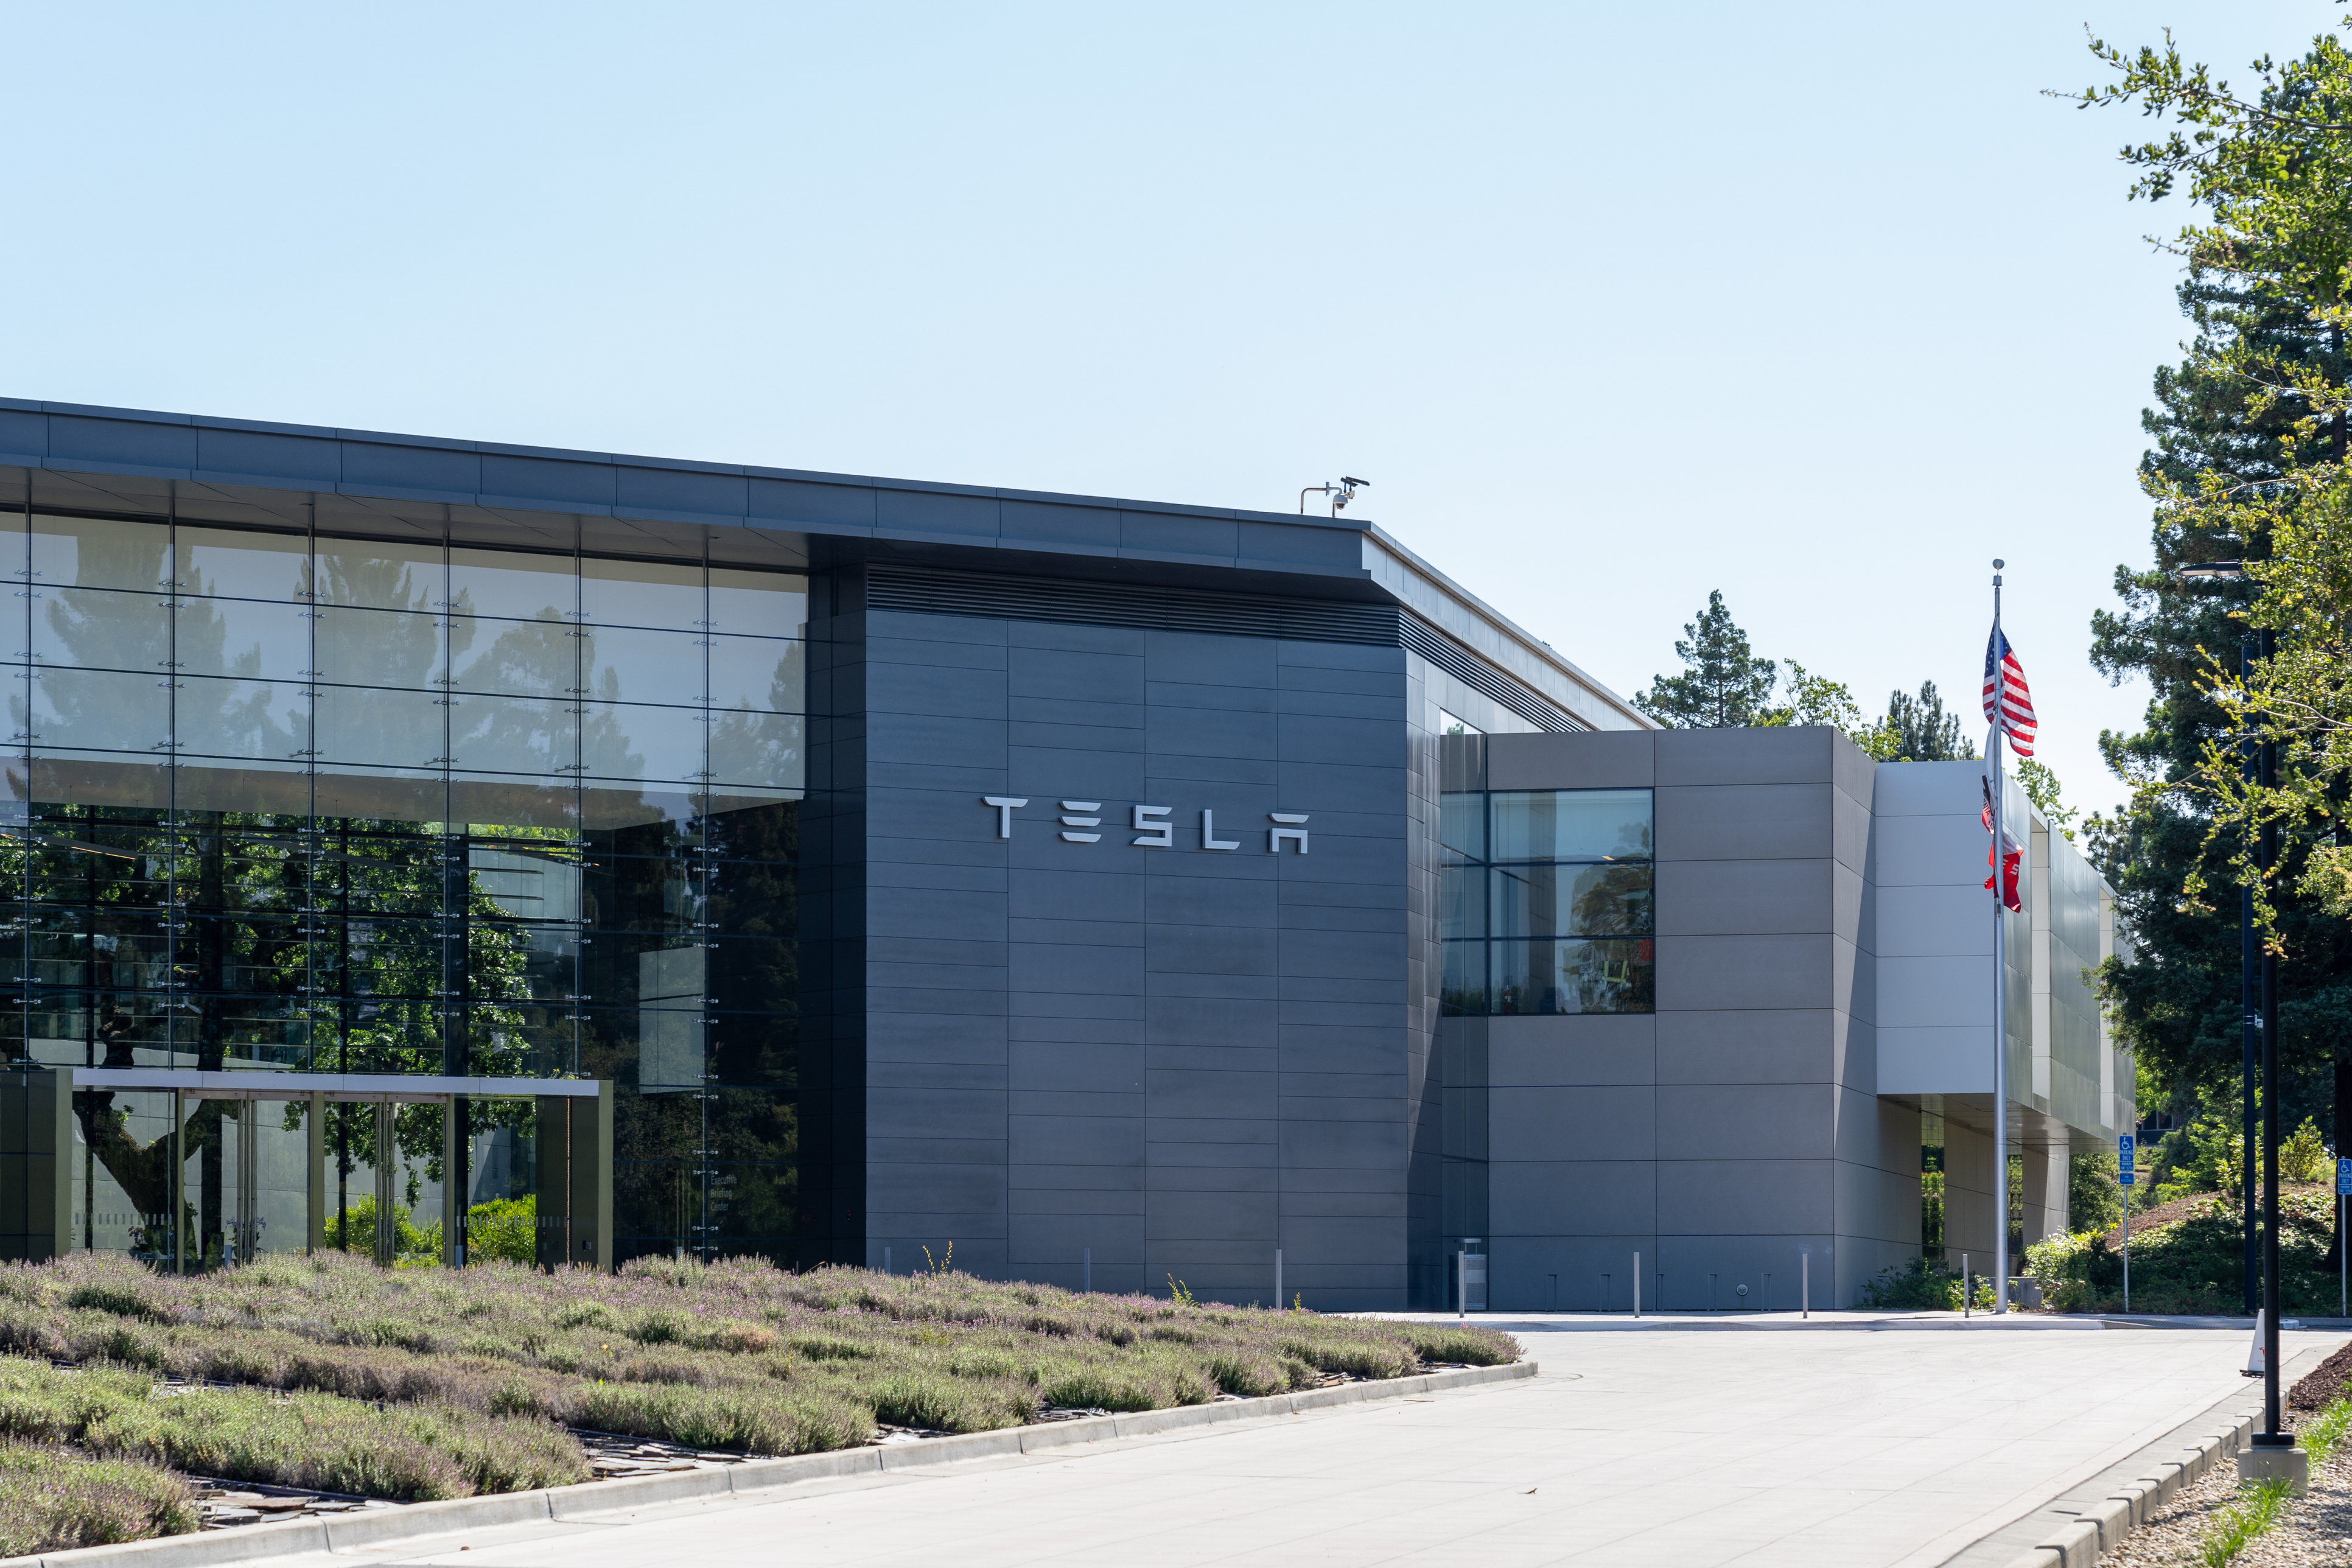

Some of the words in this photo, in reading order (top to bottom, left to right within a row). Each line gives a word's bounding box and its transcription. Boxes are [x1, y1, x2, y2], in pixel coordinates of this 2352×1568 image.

[982, 796, 1310, 855] TESLA
[710, 1174, 737, 1185] Executive
[710, 1187, 732, 1200] Briefing
[710, 1201, 729, 1211] Center
